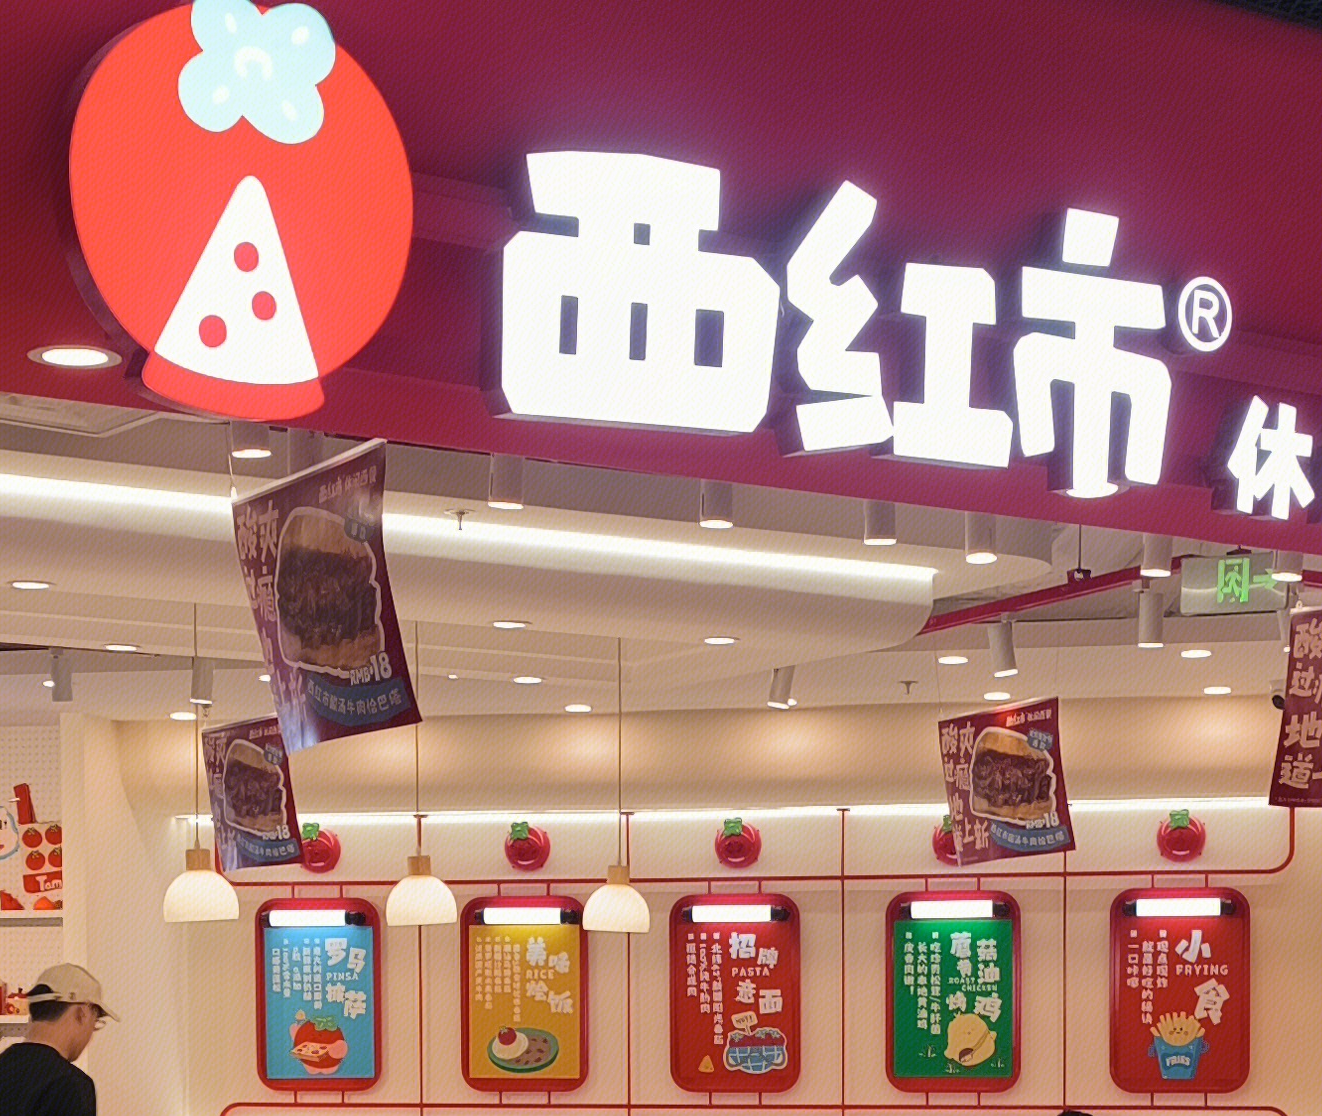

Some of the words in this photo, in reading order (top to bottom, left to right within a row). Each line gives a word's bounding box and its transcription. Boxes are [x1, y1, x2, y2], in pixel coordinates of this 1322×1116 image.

[500, 150, 1173, 498] 西红市
[324, 937, 367, 974] 罗马
[728, 931, 779, 969] 招牌
[1174, 929, 1212, 964] 小
[325, 971, 360, 982] PINSA
[525, 968, 556, 980] RICE
[731, 966, 771, 978] PASTA
[1175, 963, 1229, 976] FRYING
[734, 978, 783, 1015] 意面
[1193, 977, 1231, 1026] 食
